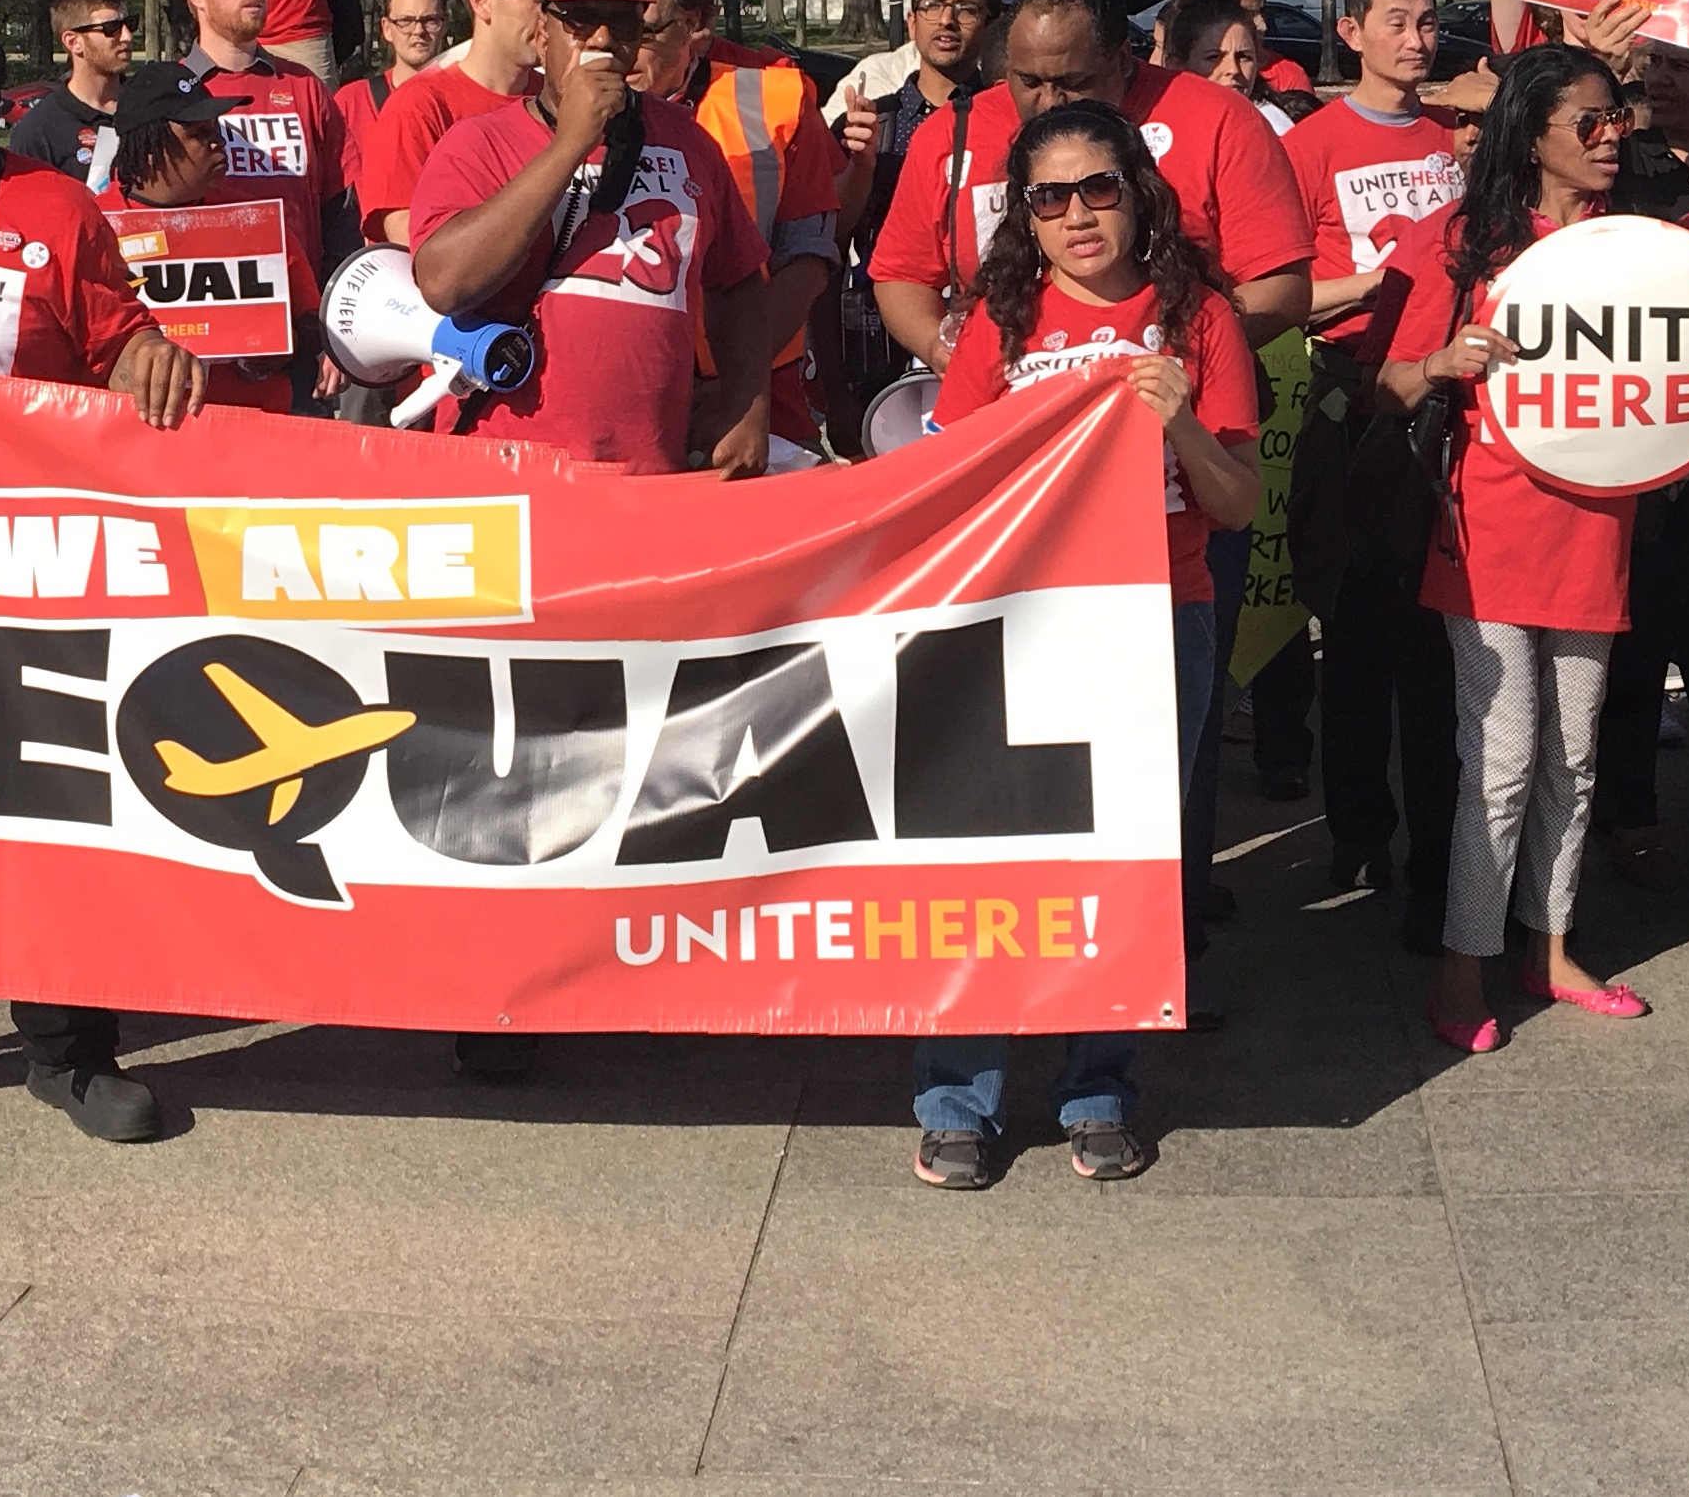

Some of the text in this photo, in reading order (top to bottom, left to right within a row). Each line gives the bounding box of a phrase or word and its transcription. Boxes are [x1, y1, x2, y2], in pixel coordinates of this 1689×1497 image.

[223, 116, 302, 143] NITE
[229, 144, 302, 173] ERE!
[142, 259, 274, 303] UAL
[337, 296, 357, 336] HERE
[241, 522, 477, 601] ARE
[613, 893, 1099, 968] UNITEHERE!
